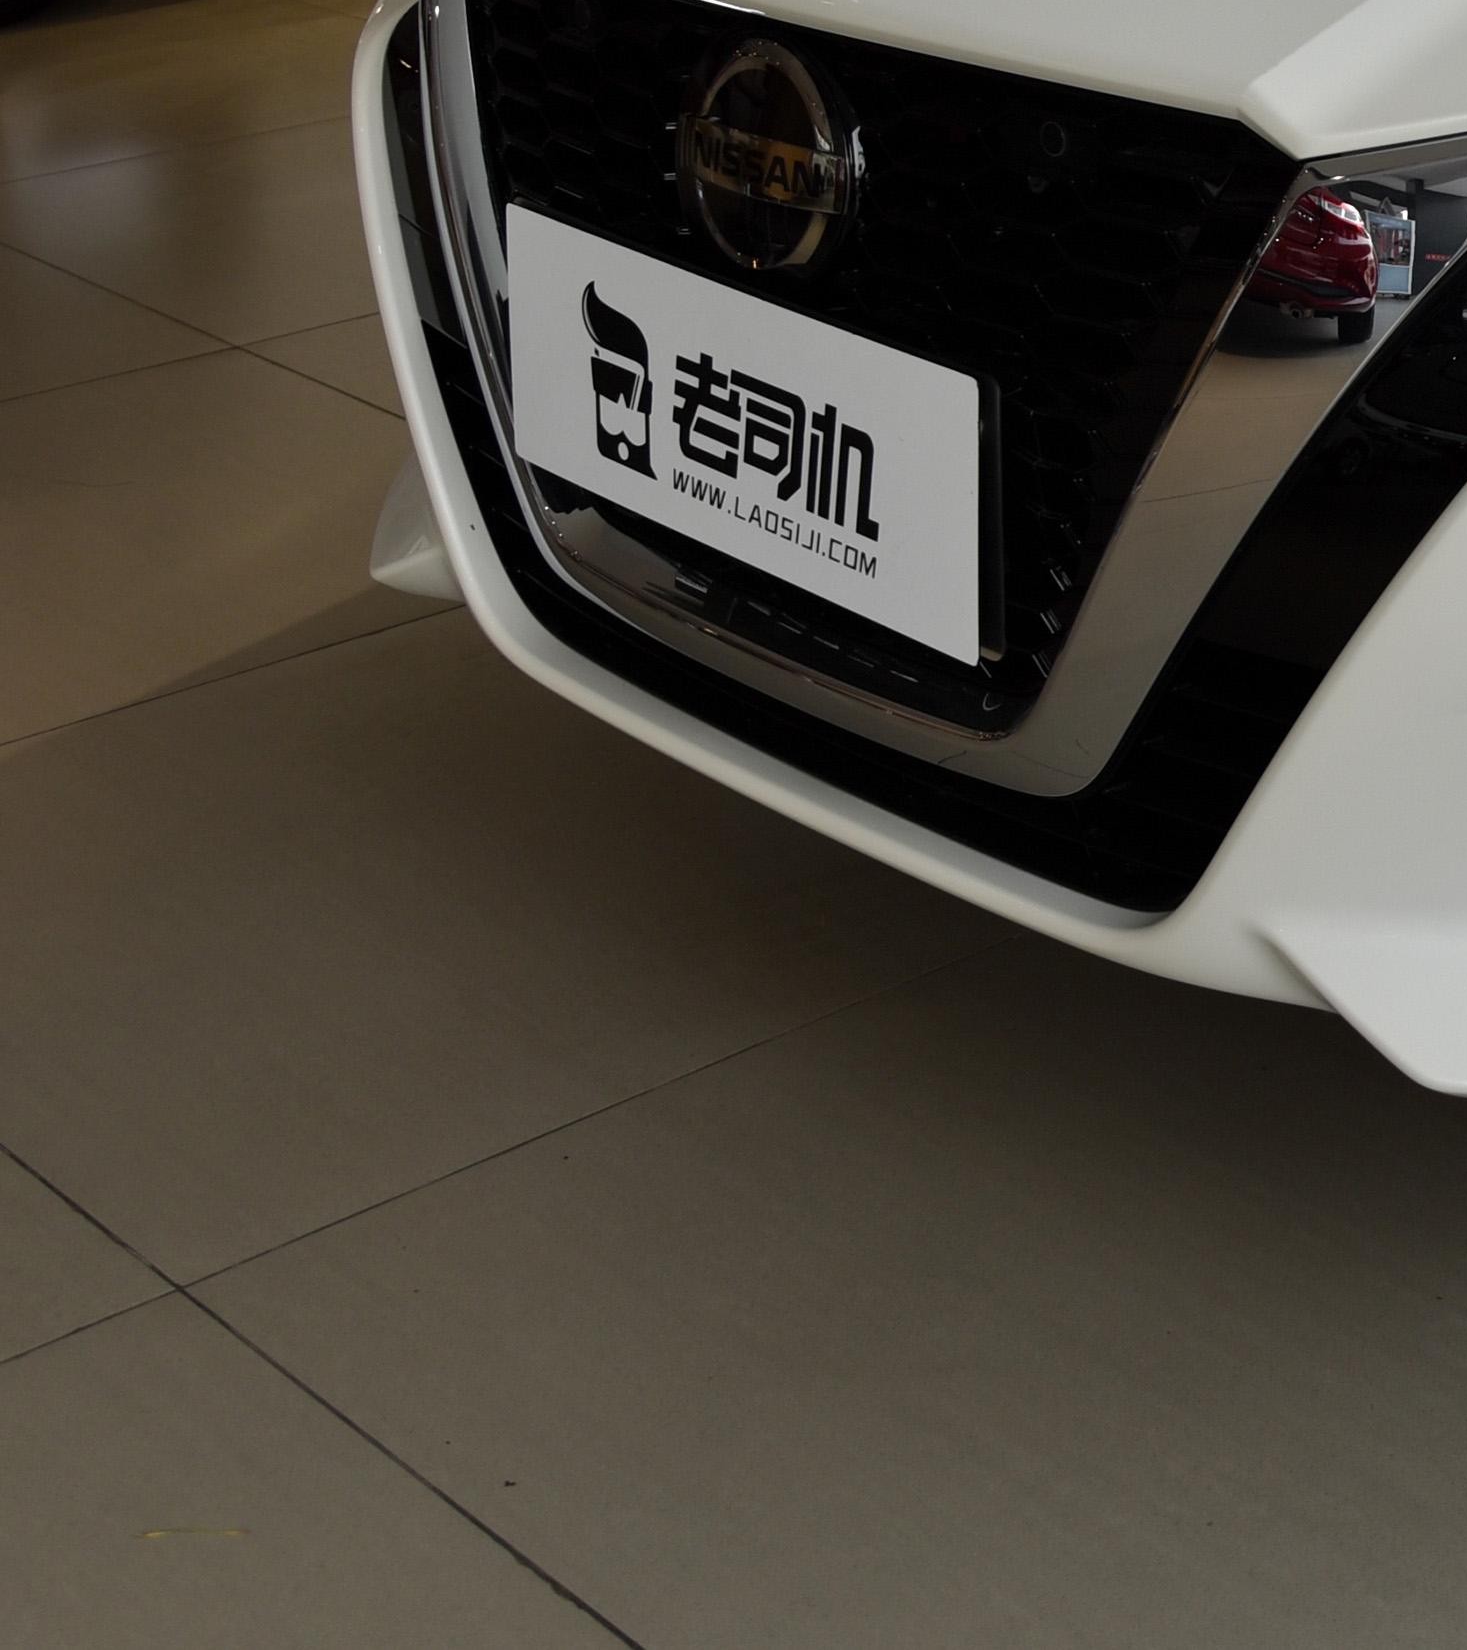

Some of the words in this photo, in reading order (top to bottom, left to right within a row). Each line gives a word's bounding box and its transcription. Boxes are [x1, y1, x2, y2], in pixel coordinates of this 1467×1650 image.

[672, 352, 880, 542] 老司机
[672, 467, 879, 580] WWW.LAOSIJI.COM
